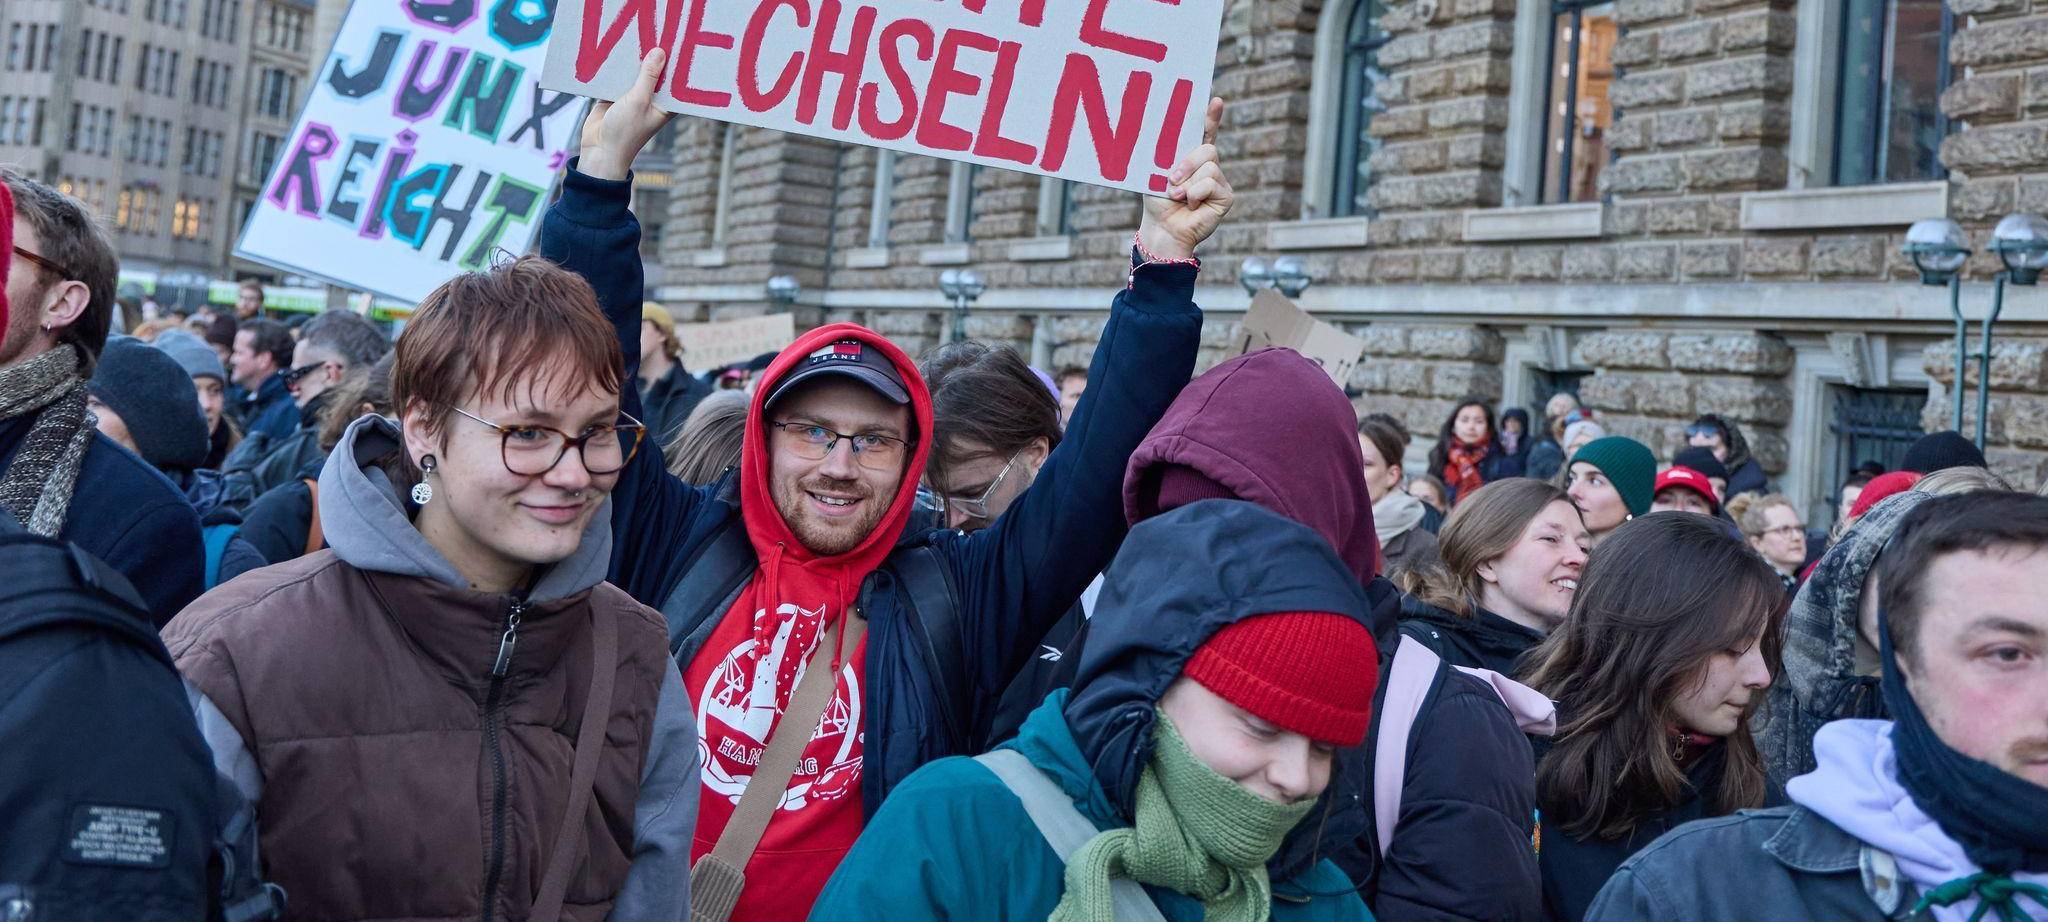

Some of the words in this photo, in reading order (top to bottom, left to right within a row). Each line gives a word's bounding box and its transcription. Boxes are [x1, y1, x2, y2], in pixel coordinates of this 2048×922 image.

[575, 0, 1193, 192] WECHSELN!
[813, 354, 856, 363] JEANS
[717, 736, 818, 775] HAMRG
